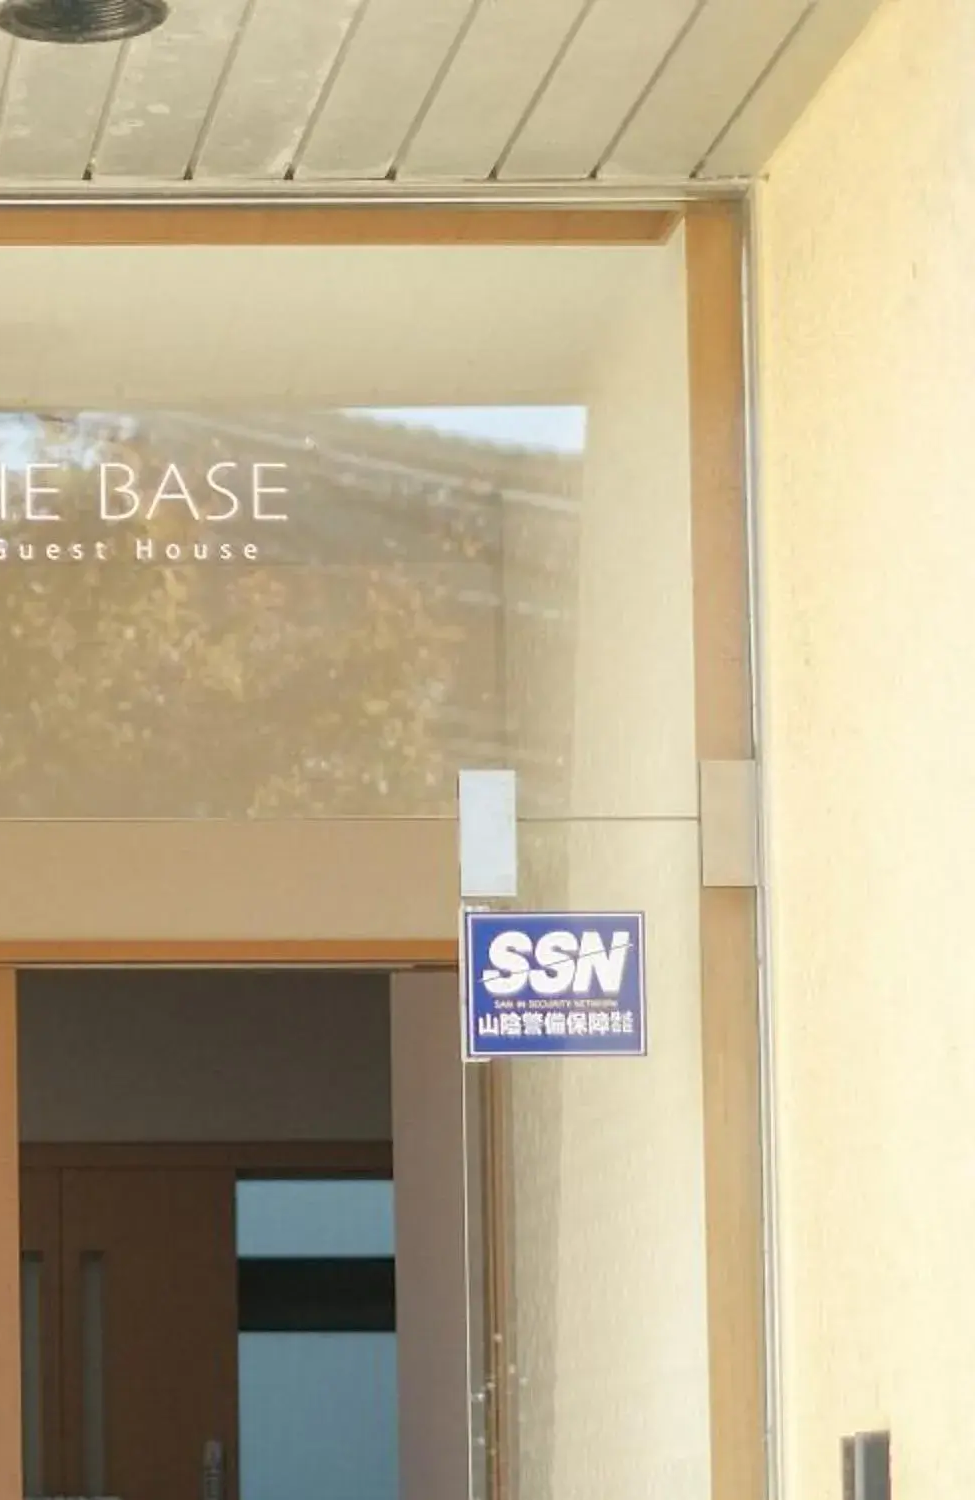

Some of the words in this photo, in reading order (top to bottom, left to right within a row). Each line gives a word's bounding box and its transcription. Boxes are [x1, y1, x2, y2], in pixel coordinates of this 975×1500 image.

[99, 462, 289, 522] BASE
[136, 539, 259, 562] House
[482, 931, 630, 994] SSN
